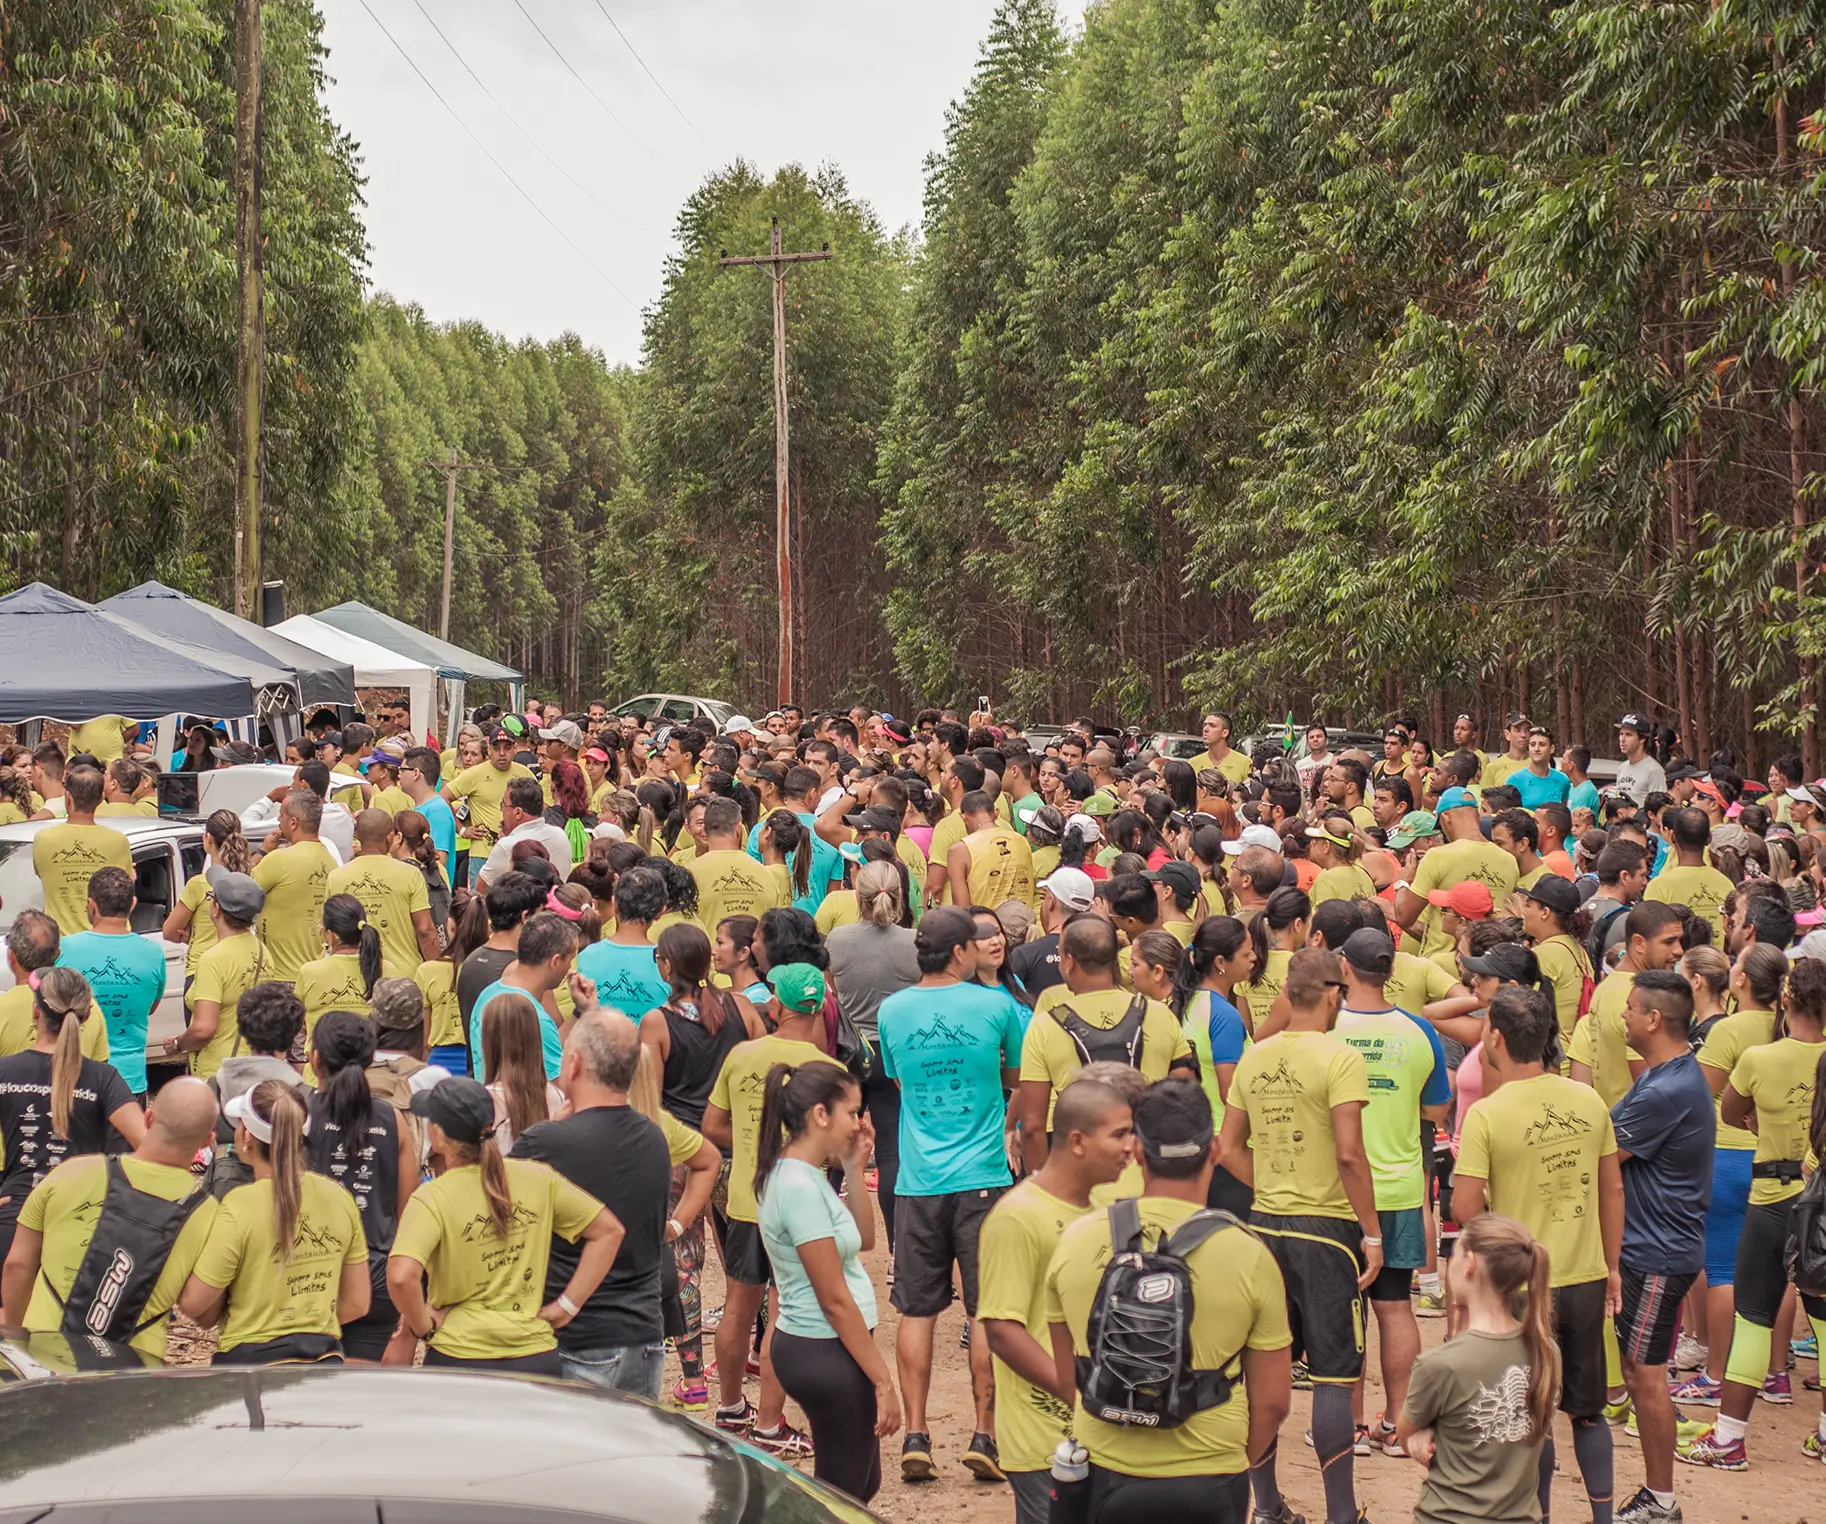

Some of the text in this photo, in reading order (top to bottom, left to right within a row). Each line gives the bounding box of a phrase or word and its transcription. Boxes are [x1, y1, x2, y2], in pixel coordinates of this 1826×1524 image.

[1373, 1037, 1385, 1048] da
[925, 1067, 958, 1079] Limites
[1546, 1159, 1577, 1174] Limites
[291, 1283, 326, 1297] Limites
